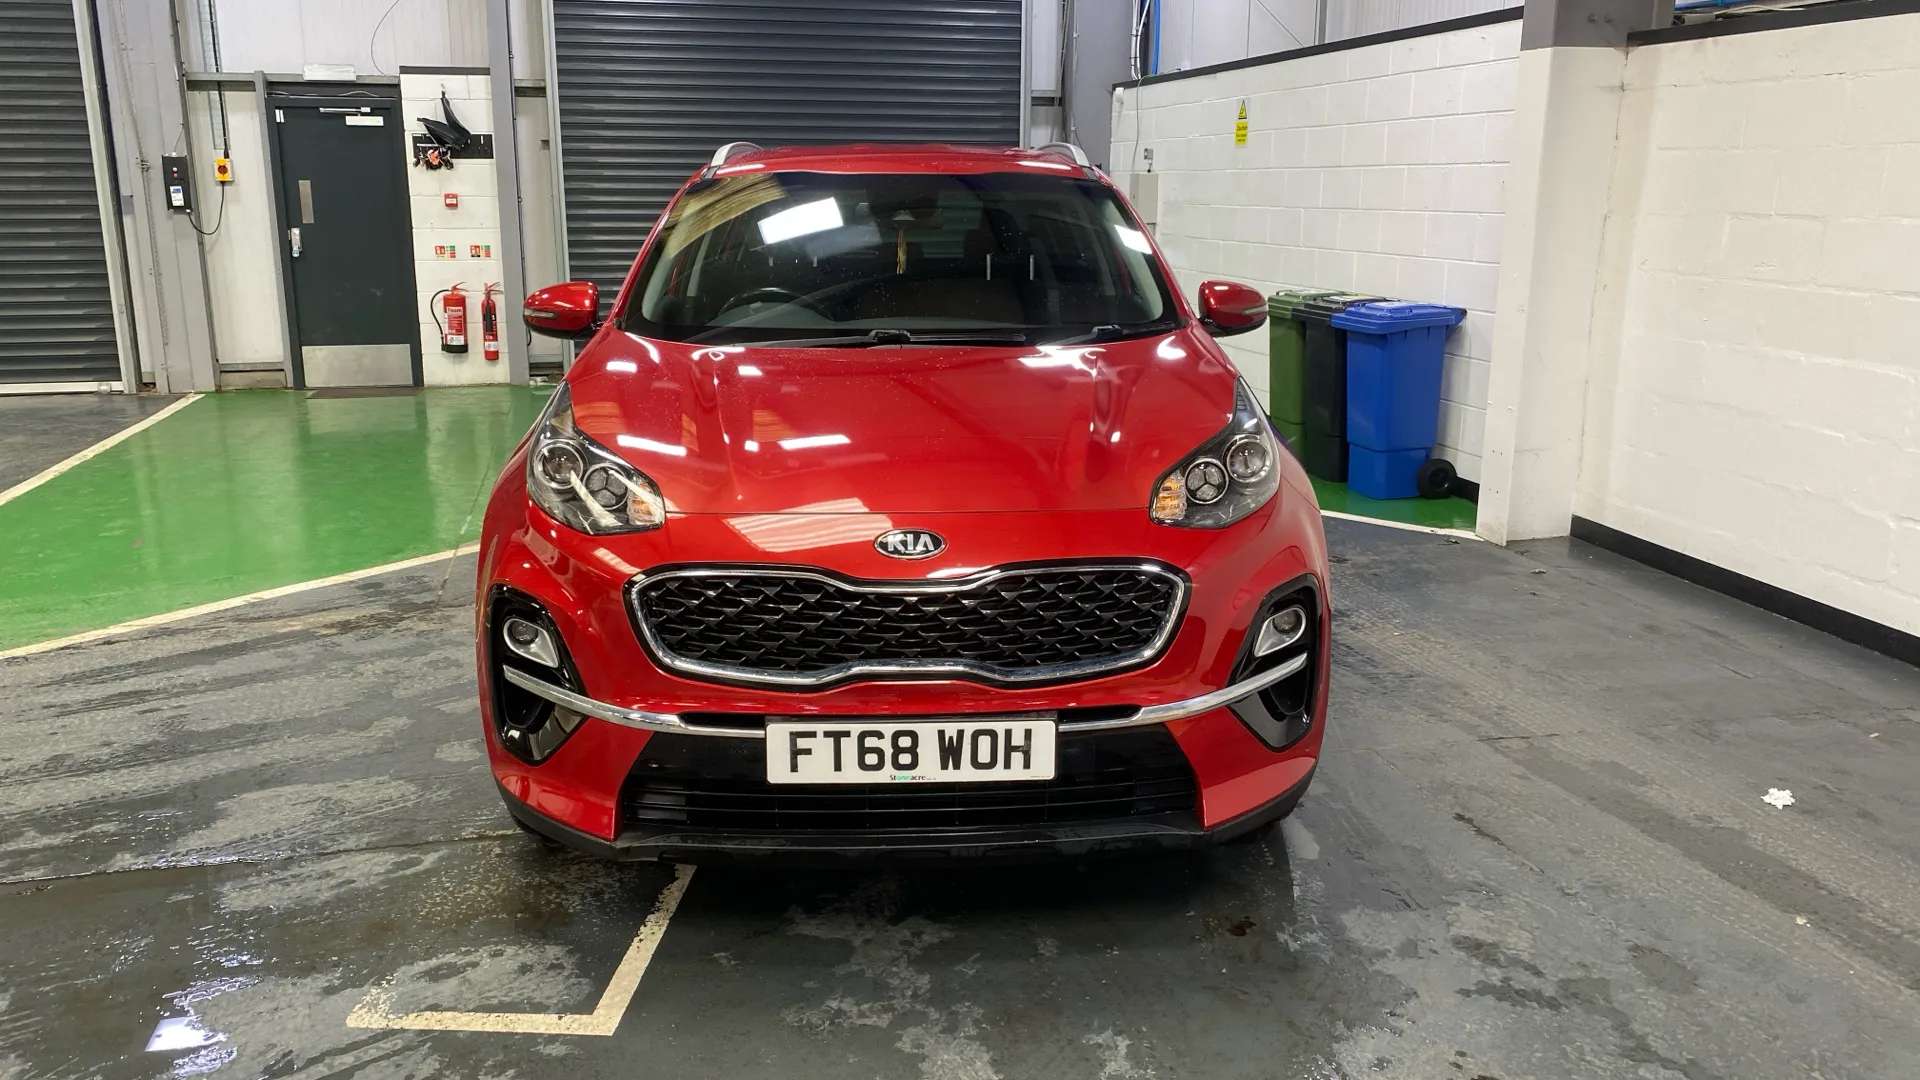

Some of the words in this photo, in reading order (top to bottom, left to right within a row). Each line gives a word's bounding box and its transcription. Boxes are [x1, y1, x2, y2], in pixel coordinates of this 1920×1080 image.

[882, 533, 935, 553] KIA
[789, 729, 919, 773] FT68
[937, 728, 1032, 771] WOH
